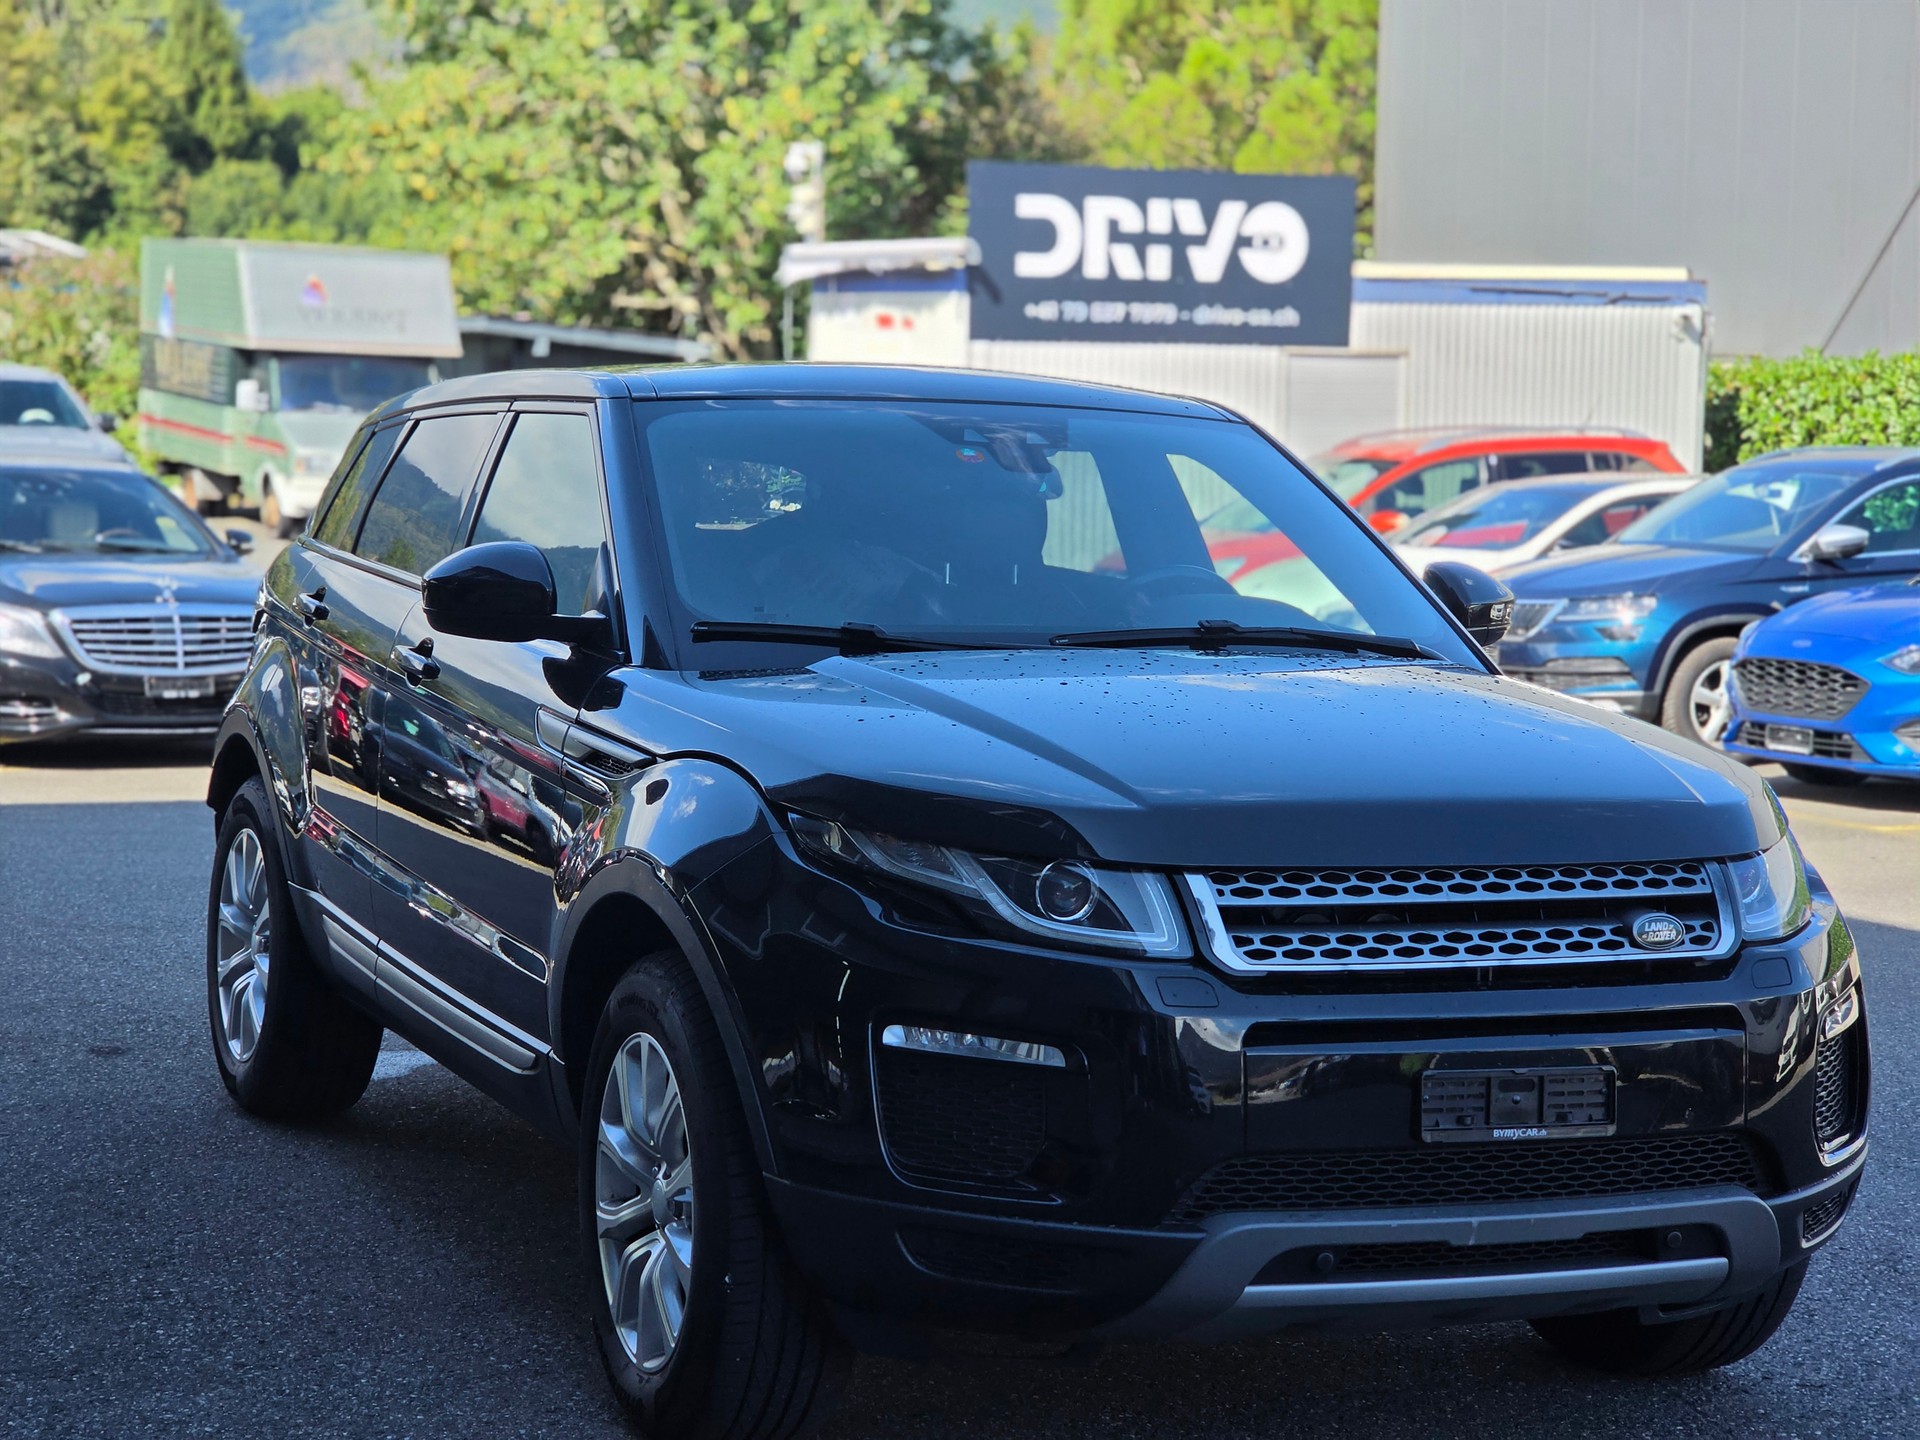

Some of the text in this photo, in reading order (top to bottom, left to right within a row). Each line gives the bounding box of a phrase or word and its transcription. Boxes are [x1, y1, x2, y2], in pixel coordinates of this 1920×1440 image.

[1014, 193, 1309, 284] DRIVO
[1645, 922, 1668, 932] LAND
[1647, 929, 1676, 941] ROVER
